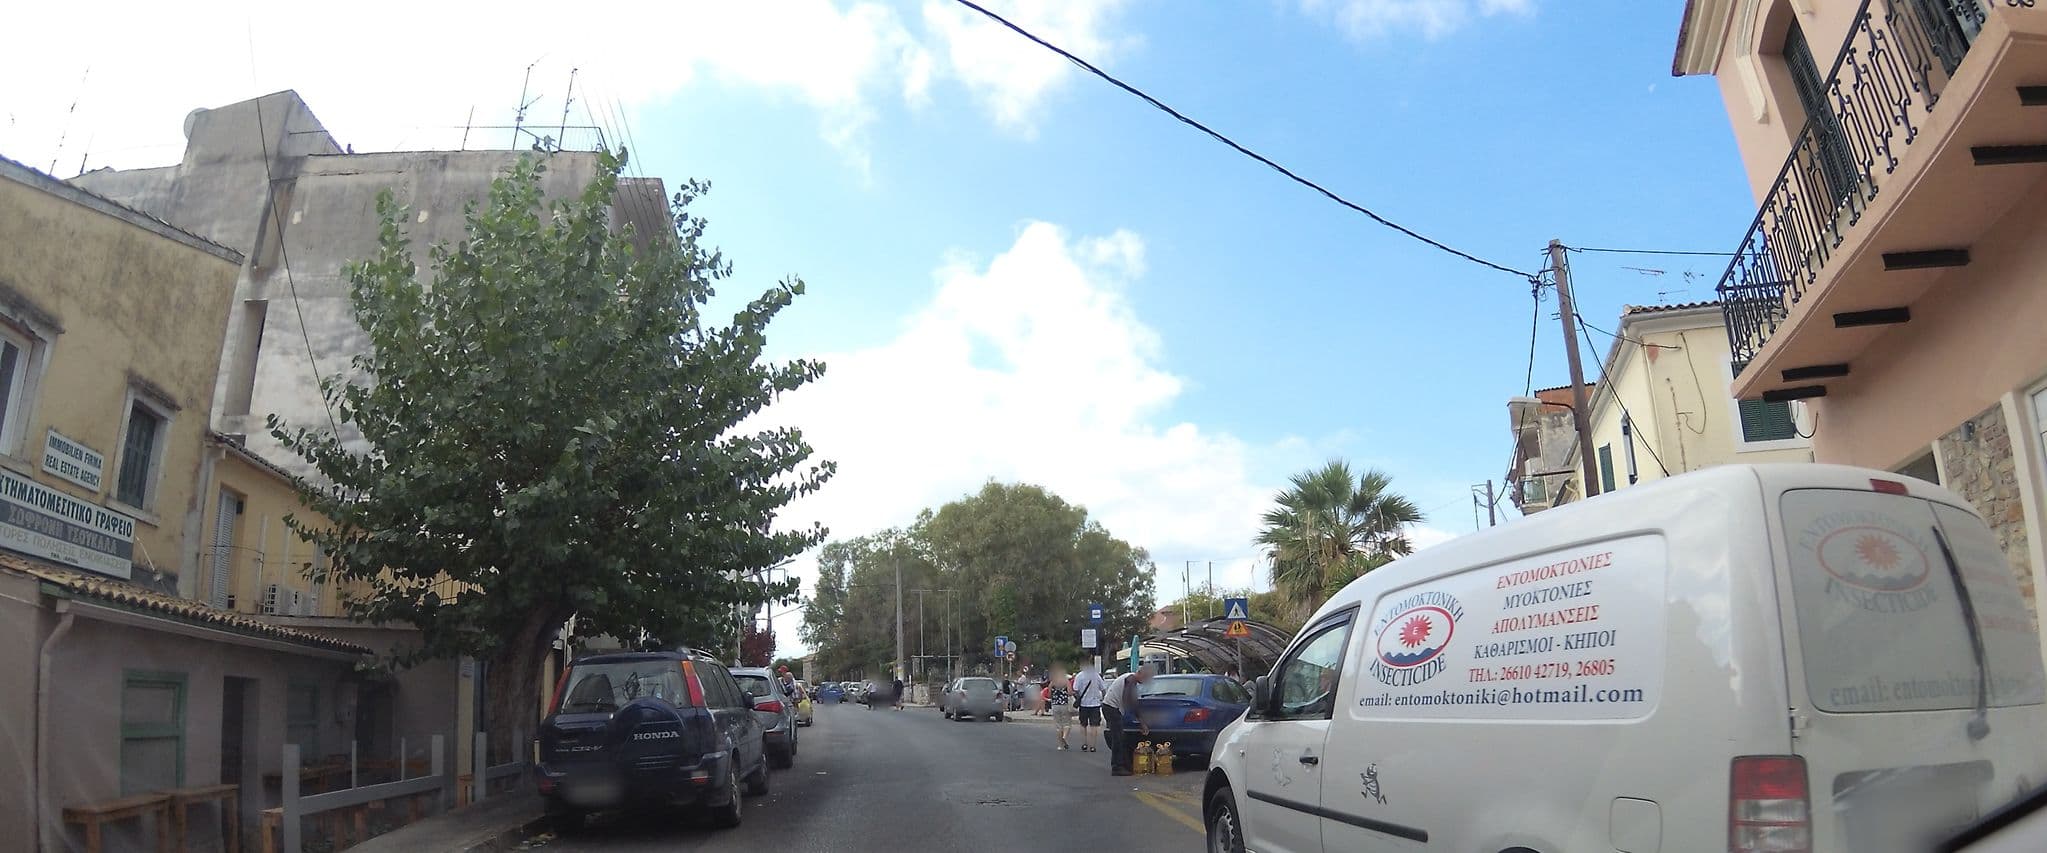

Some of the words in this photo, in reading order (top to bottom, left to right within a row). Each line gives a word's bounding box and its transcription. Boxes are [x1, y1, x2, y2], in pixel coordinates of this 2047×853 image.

[49, 435, 83, 461] IMMOBILIEN
[84, 452, 102, 469] FIRMA
[45, 454, 59, 471] REAL
[60, 460, 80, 479] ESTATE
[80, 469, 100, 487] AGENCY
[95, 510, 132, 538] ΓΡΑΦΕΙΟ
[1496, 551, 1613, 589] ΕΝΤΟΜΟΚΤΟΝΙΕΣ
[1503, 580, 1593, 610] ΜΥΟΚΤΟΝΙΕΣ
[1491, 604, 1600, 634] ΑΠΟΛΥΜΑΝΣΕΙΣ
[1474, 636, 1554, 659] ΚΑΘΑΡΙΣΜΟΙ
[1563, 629, 1616, 651] ΚΗΠΟΙ
[1369, 653, 1447, 687] INSECTICIDE
[1500, 664, 1531, 681] 26610
[1534, 662, 1572, 680] 42719,
[1575, 658, 1615, 677] 26805
[1359, 692, 1392, 706] email:
[1394, 684, 1643, 706] entomoktoniki@hotmail.com
[633, 730, 680, 740] HONDA
